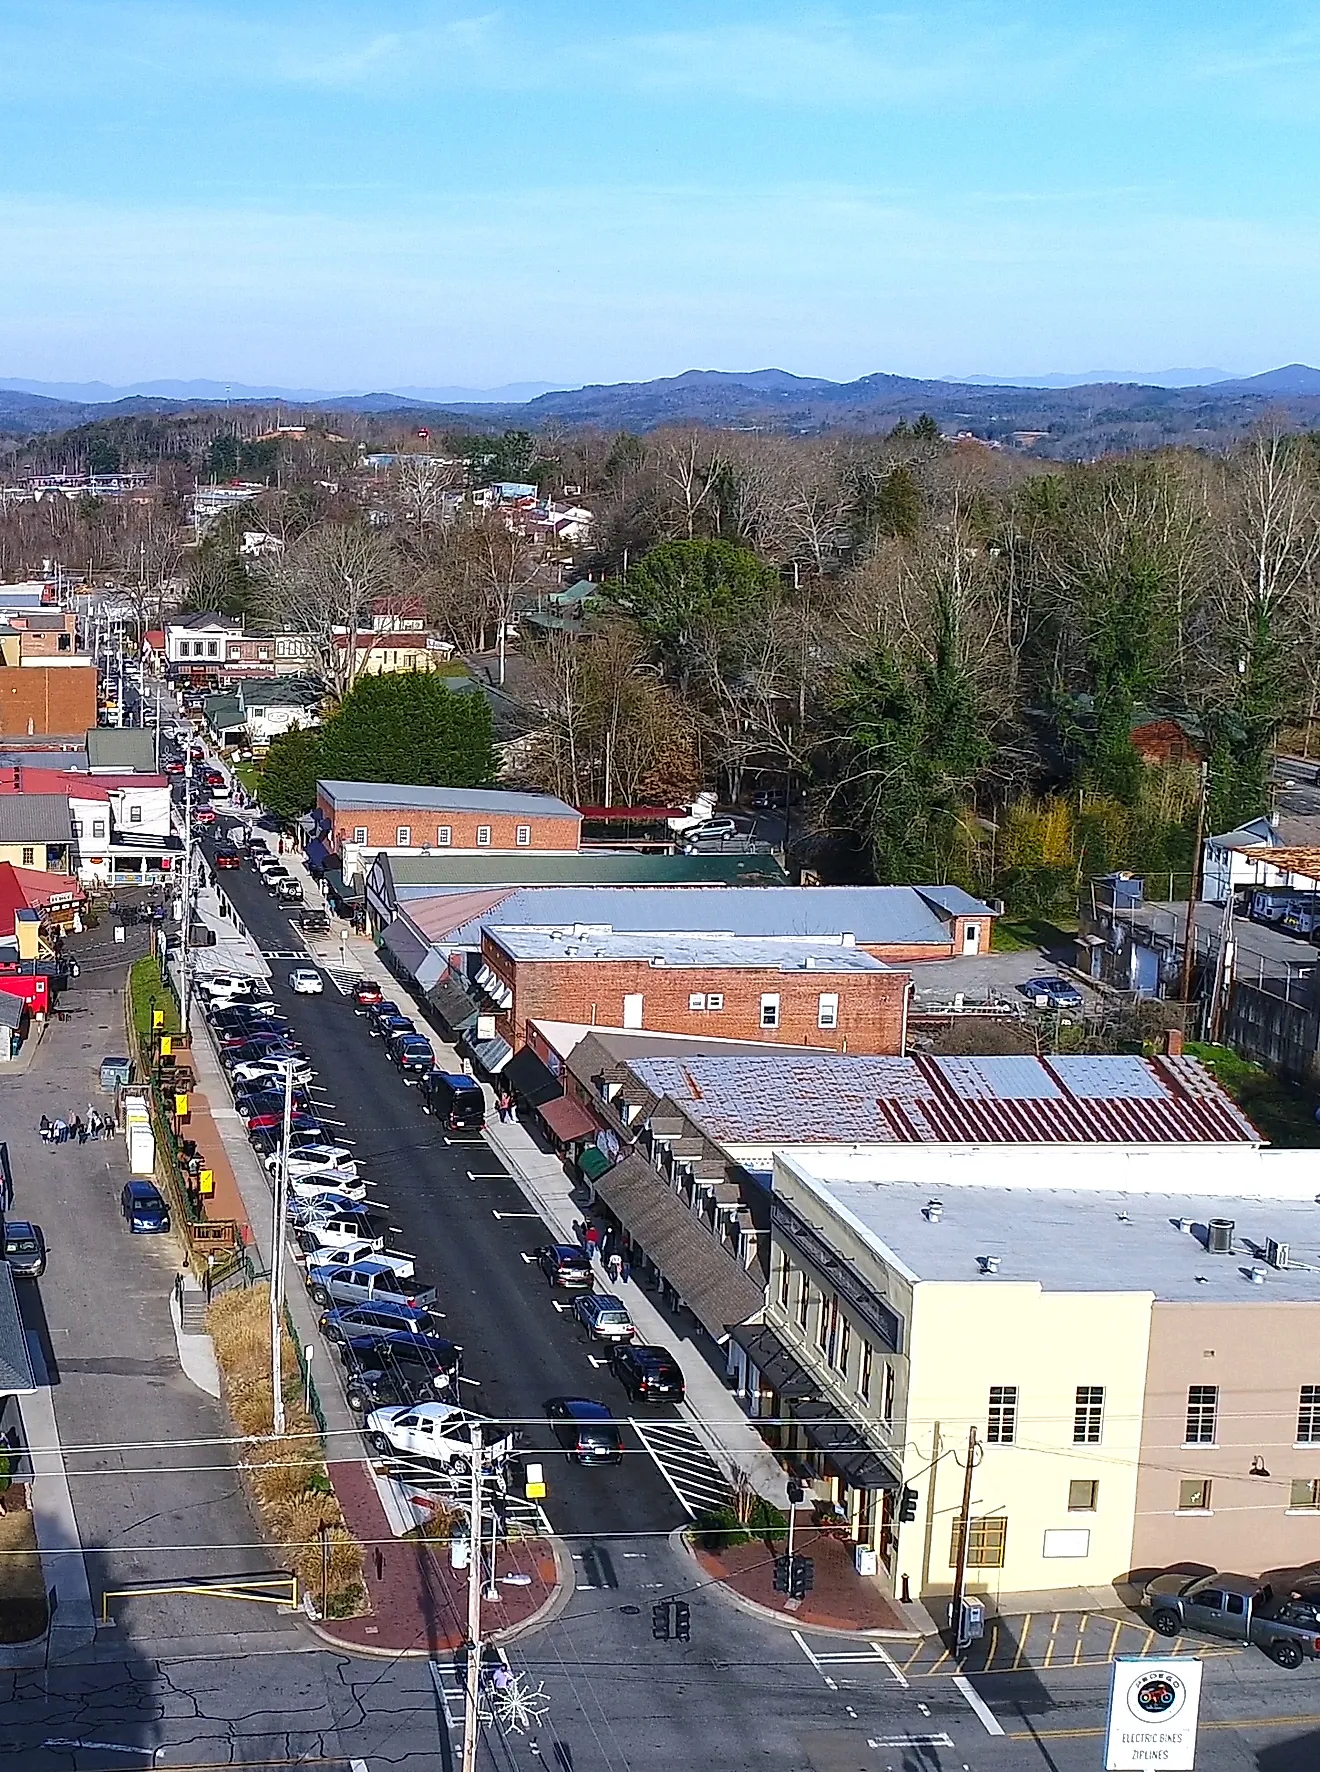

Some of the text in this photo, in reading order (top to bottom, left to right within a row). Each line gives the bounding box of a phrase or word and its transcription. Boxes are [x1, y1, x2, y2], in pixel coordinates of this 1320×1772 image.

[1135, 1673, 1180, 1689] PEDEGO
[1122, 1733, 1183, 1744] ELECTRIC BIKES
[1132, 1749, 1169, 1760] ZIPLINES
